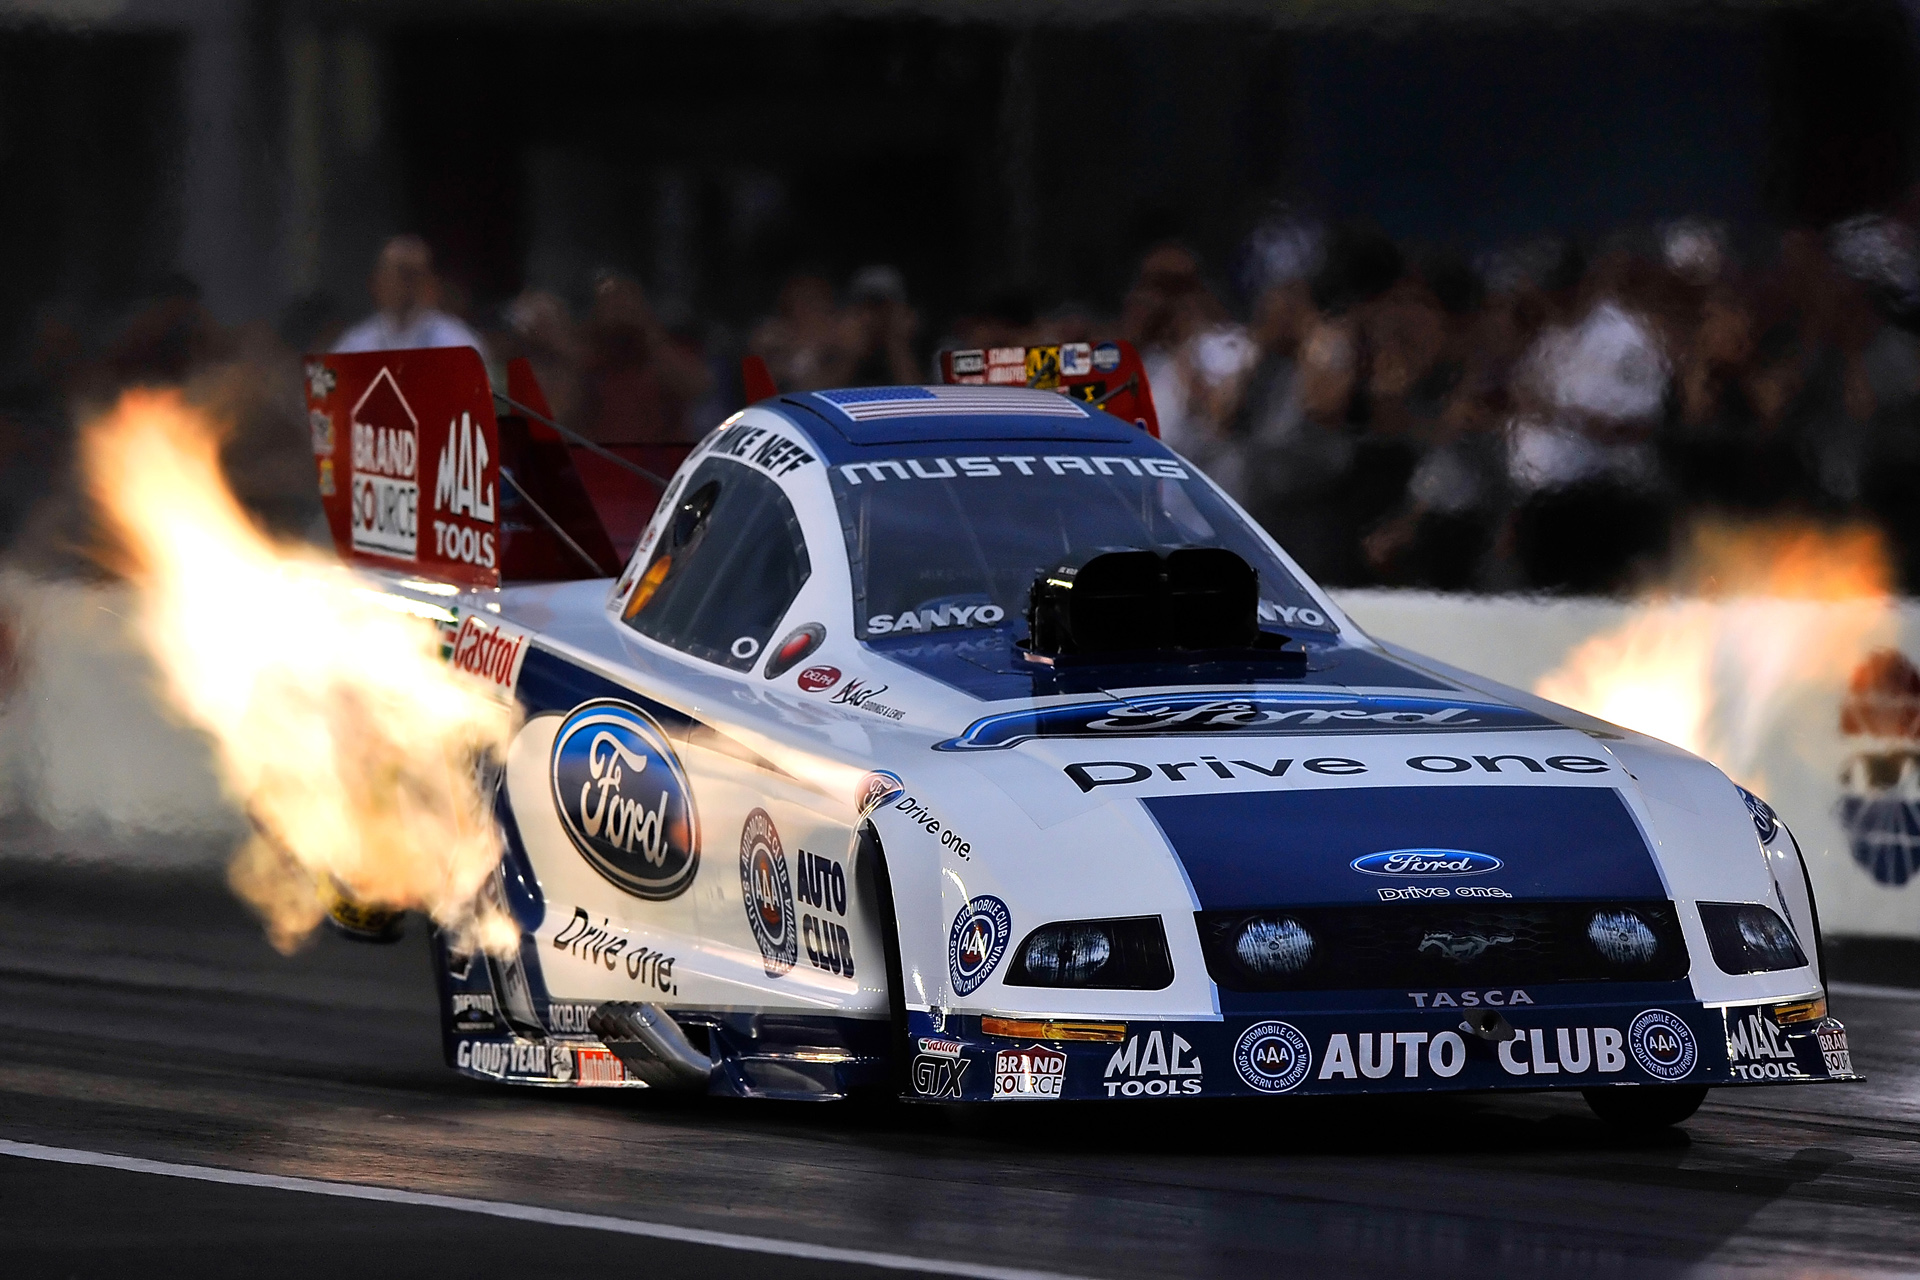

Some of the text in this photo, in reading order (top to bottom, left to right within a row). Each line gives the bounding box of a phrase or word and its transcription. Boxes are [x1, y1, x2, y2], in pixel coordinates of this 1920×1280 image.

[353, 422, 416, 477] BRAND
[434, 410, 496, 524] MAC
[709, 424, 768, 457] MIKE
[748, 433, 817, 478] NEFF
[839, 456, 1191, 486] MUSTANG
[353, 480, 417, 538] SOURCE
[433, 519, 496, 569] TOOLS
[866, 603, 1005, 635] SANYO
[453, 613, 524, 688] Castrol
[802, 669, 836, 687] DELPHI
[1086, 699, 1482, 731] Ford
[1063, 752, 1368, 794] Drive
[580, 730, 669, 868] Ford
[894, 796, 973, 863] Drive one.
[741, 814, 789, 885] AUTOMOBILE CLUB
[1383, 852, 1473, 873] Ford
[754, 868, 781, 912] AAA
[797, 848, 847, 917] AUTO
[1377, 885, 1513, 901] Drive one.
[953, 898, 1010, 939] AUTOMOBILE CLUB
[553, 905, 678, 997] Drive one.
[802, 912, 855, 979] CLUB
[960, 930, 989, 956] AAA
[962, 944, 1005, 993] CALIFORNIA
[1407, 989, 1535, 1008] TASCA
[1240, 1025, 1304, 1052] AUTOMOBILE CLUB
[1633, 1013, 1688, 1039] AUTOMOBILE CLUB
[1649, 1034, 1678, 1052] AAA
[1730, 1014, 1796, 1062] MAC
[1819, 1033, 1849, 1051] BRAN
[456, 1040, 548, 1077] GOODYEAR
[580, 1051, 622, 1082] Autolite
[997, 1055, 1063, 1074] BRAND
[1104, 1030, 1203, 1078] MAC
[1238, 1053, 1308, 1089] SOUTHERN CALIFORNIA
[1256, 1046, 1290, 1064] AAA
[1317, 1027, 1627, 1080] AUTO CLUB
[1633, 1041, 1694, 1076] SOUTHERN CALIFORNIA
[1735, 1062, 1801, 1080] TOOLS
[911, 1053, 972, 1099] GTX
[994, 1074, 1063, 1094] SOURCE
[1103, 1078, 1203, 1097] TOOLS
